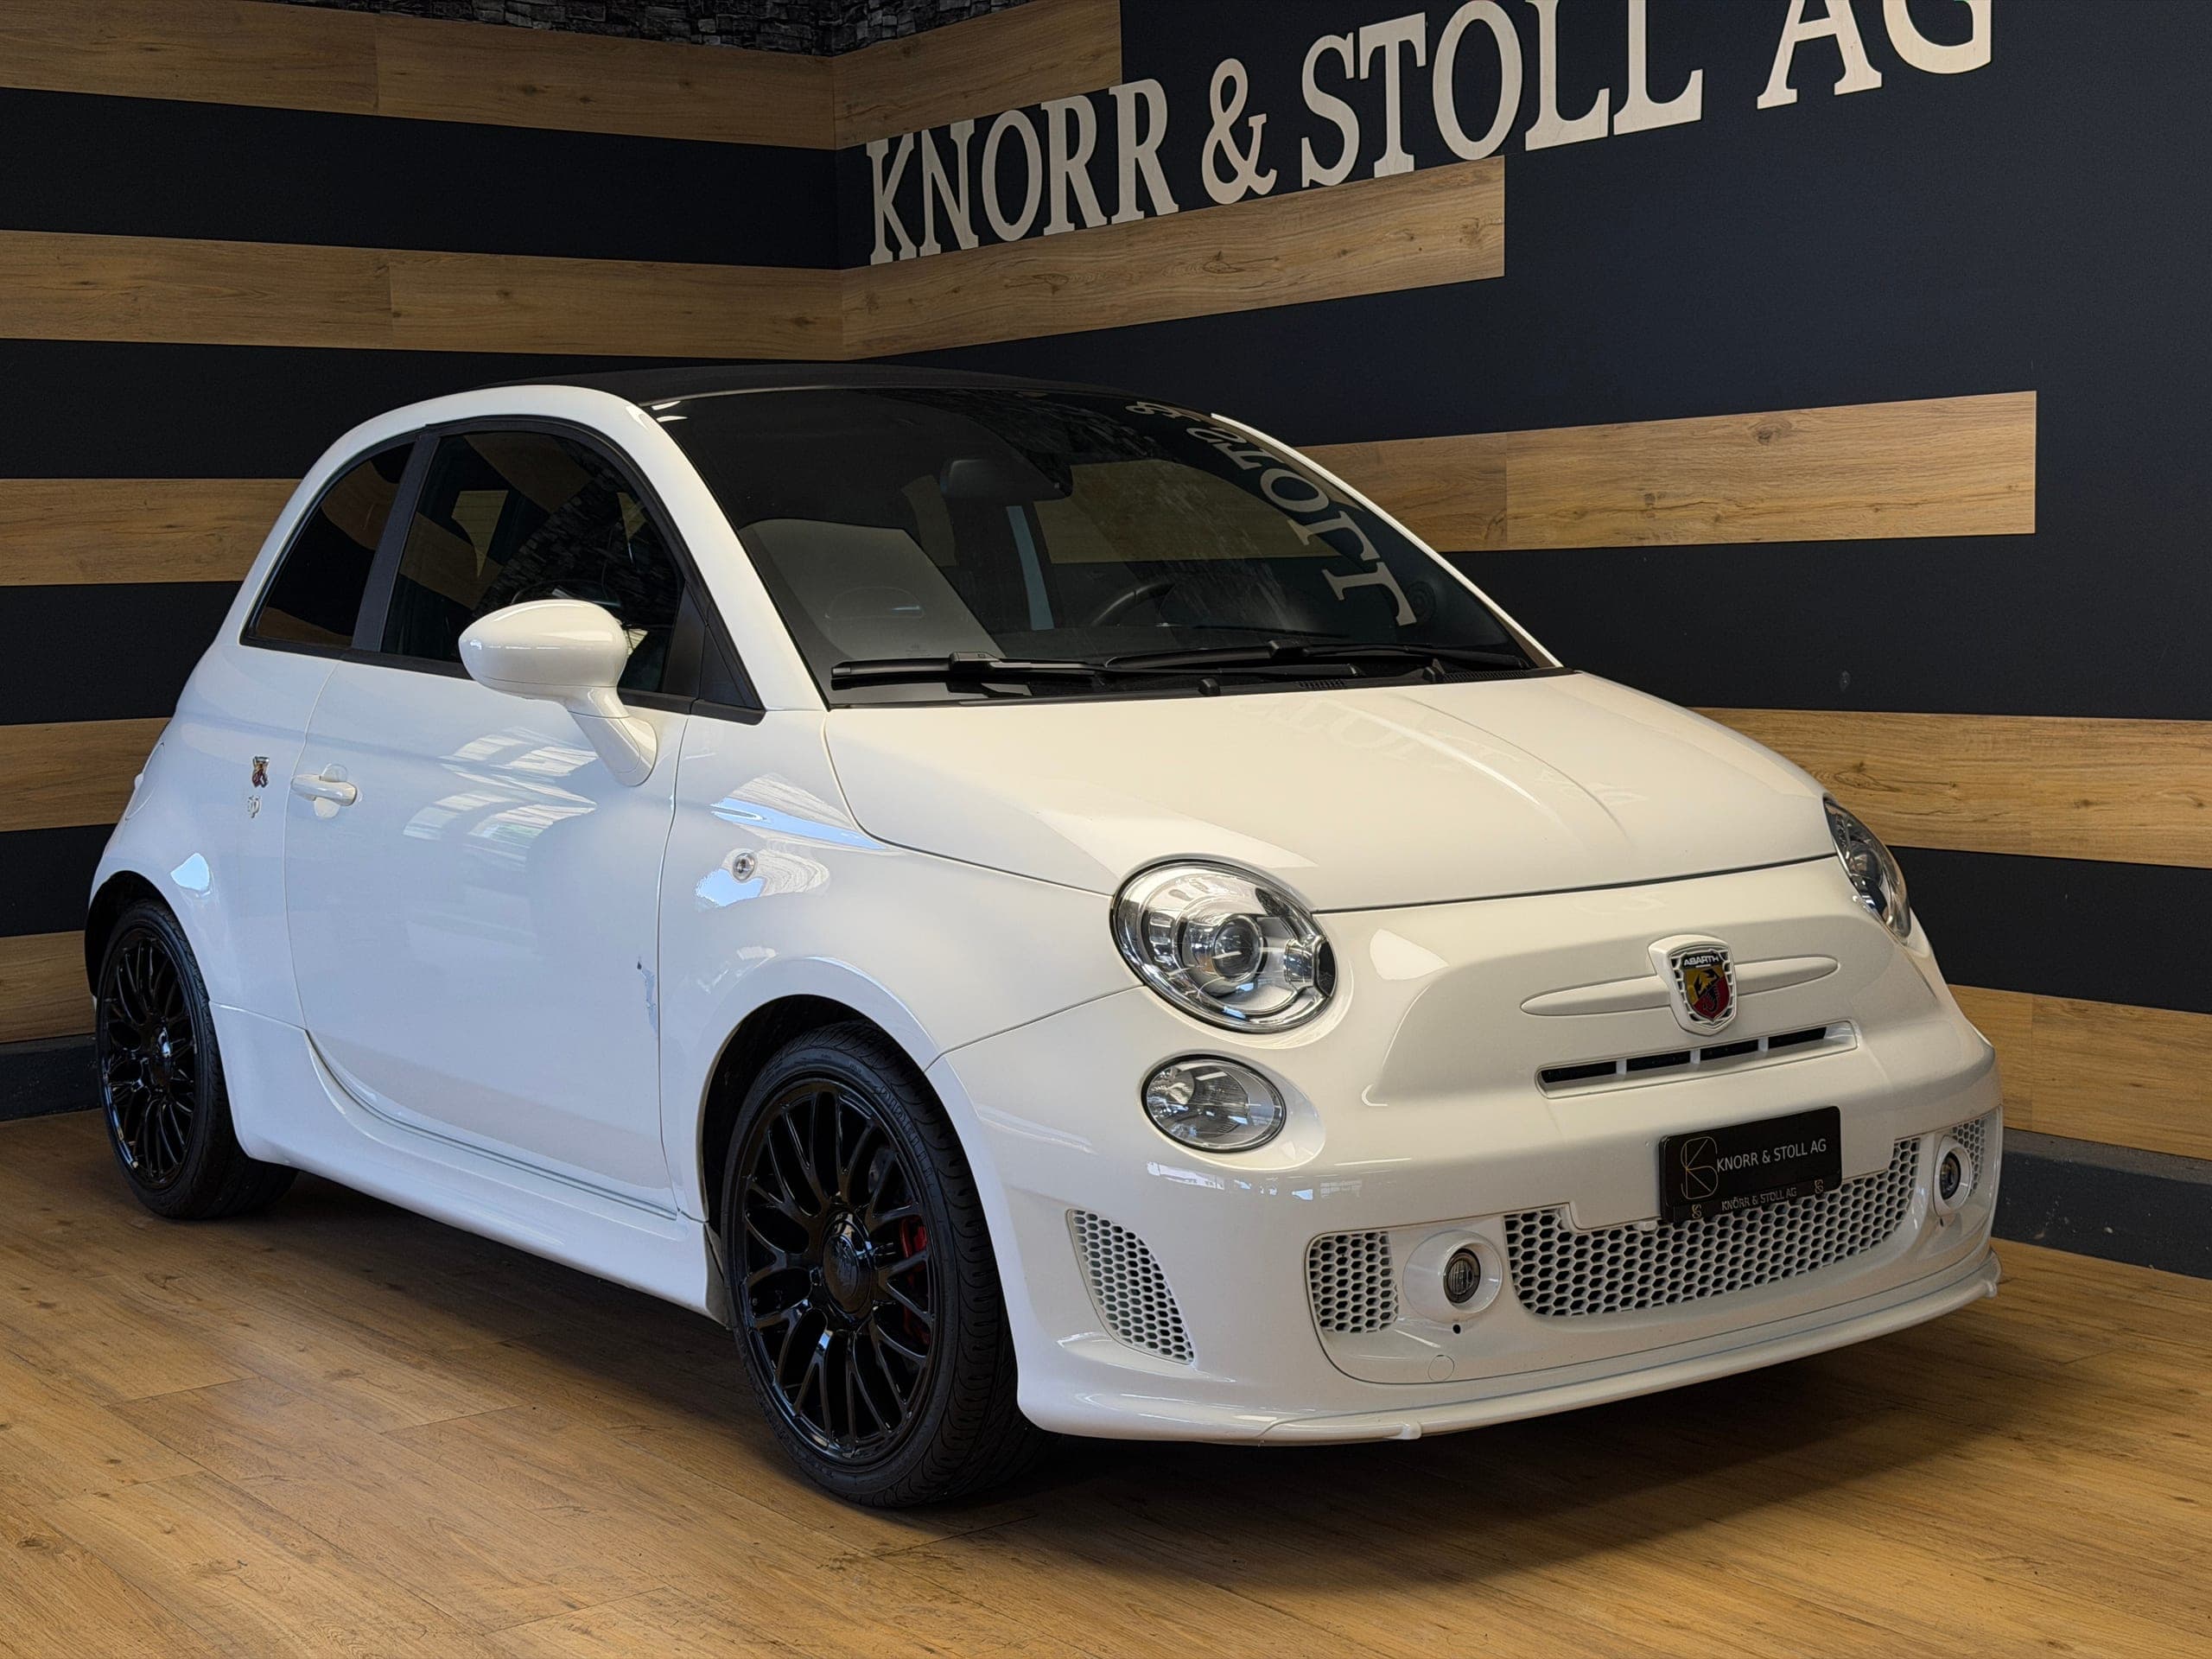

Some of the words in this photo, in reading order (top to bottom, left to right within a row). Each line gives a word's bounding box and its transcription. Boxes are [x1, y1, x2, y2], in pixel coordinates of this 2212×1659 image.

[867, 79, 1179, 265] KNORR
[1202, 58, 1277, 205] &
[1301, 0, 1703, 188] STOLL
[1684, 956, 1719, 966] ABARTH
[1716, 1152, 1759, 1173] KNORR
[1762, 1149, 1771, 1164] &
[1774, 1141, 1808, 1162] STOLL
[1810, 1138, 1827, 1154] AG
[1760, 1191, 1784, 1206] STOLL
[1785, 1187, 1797, 1200] AG
